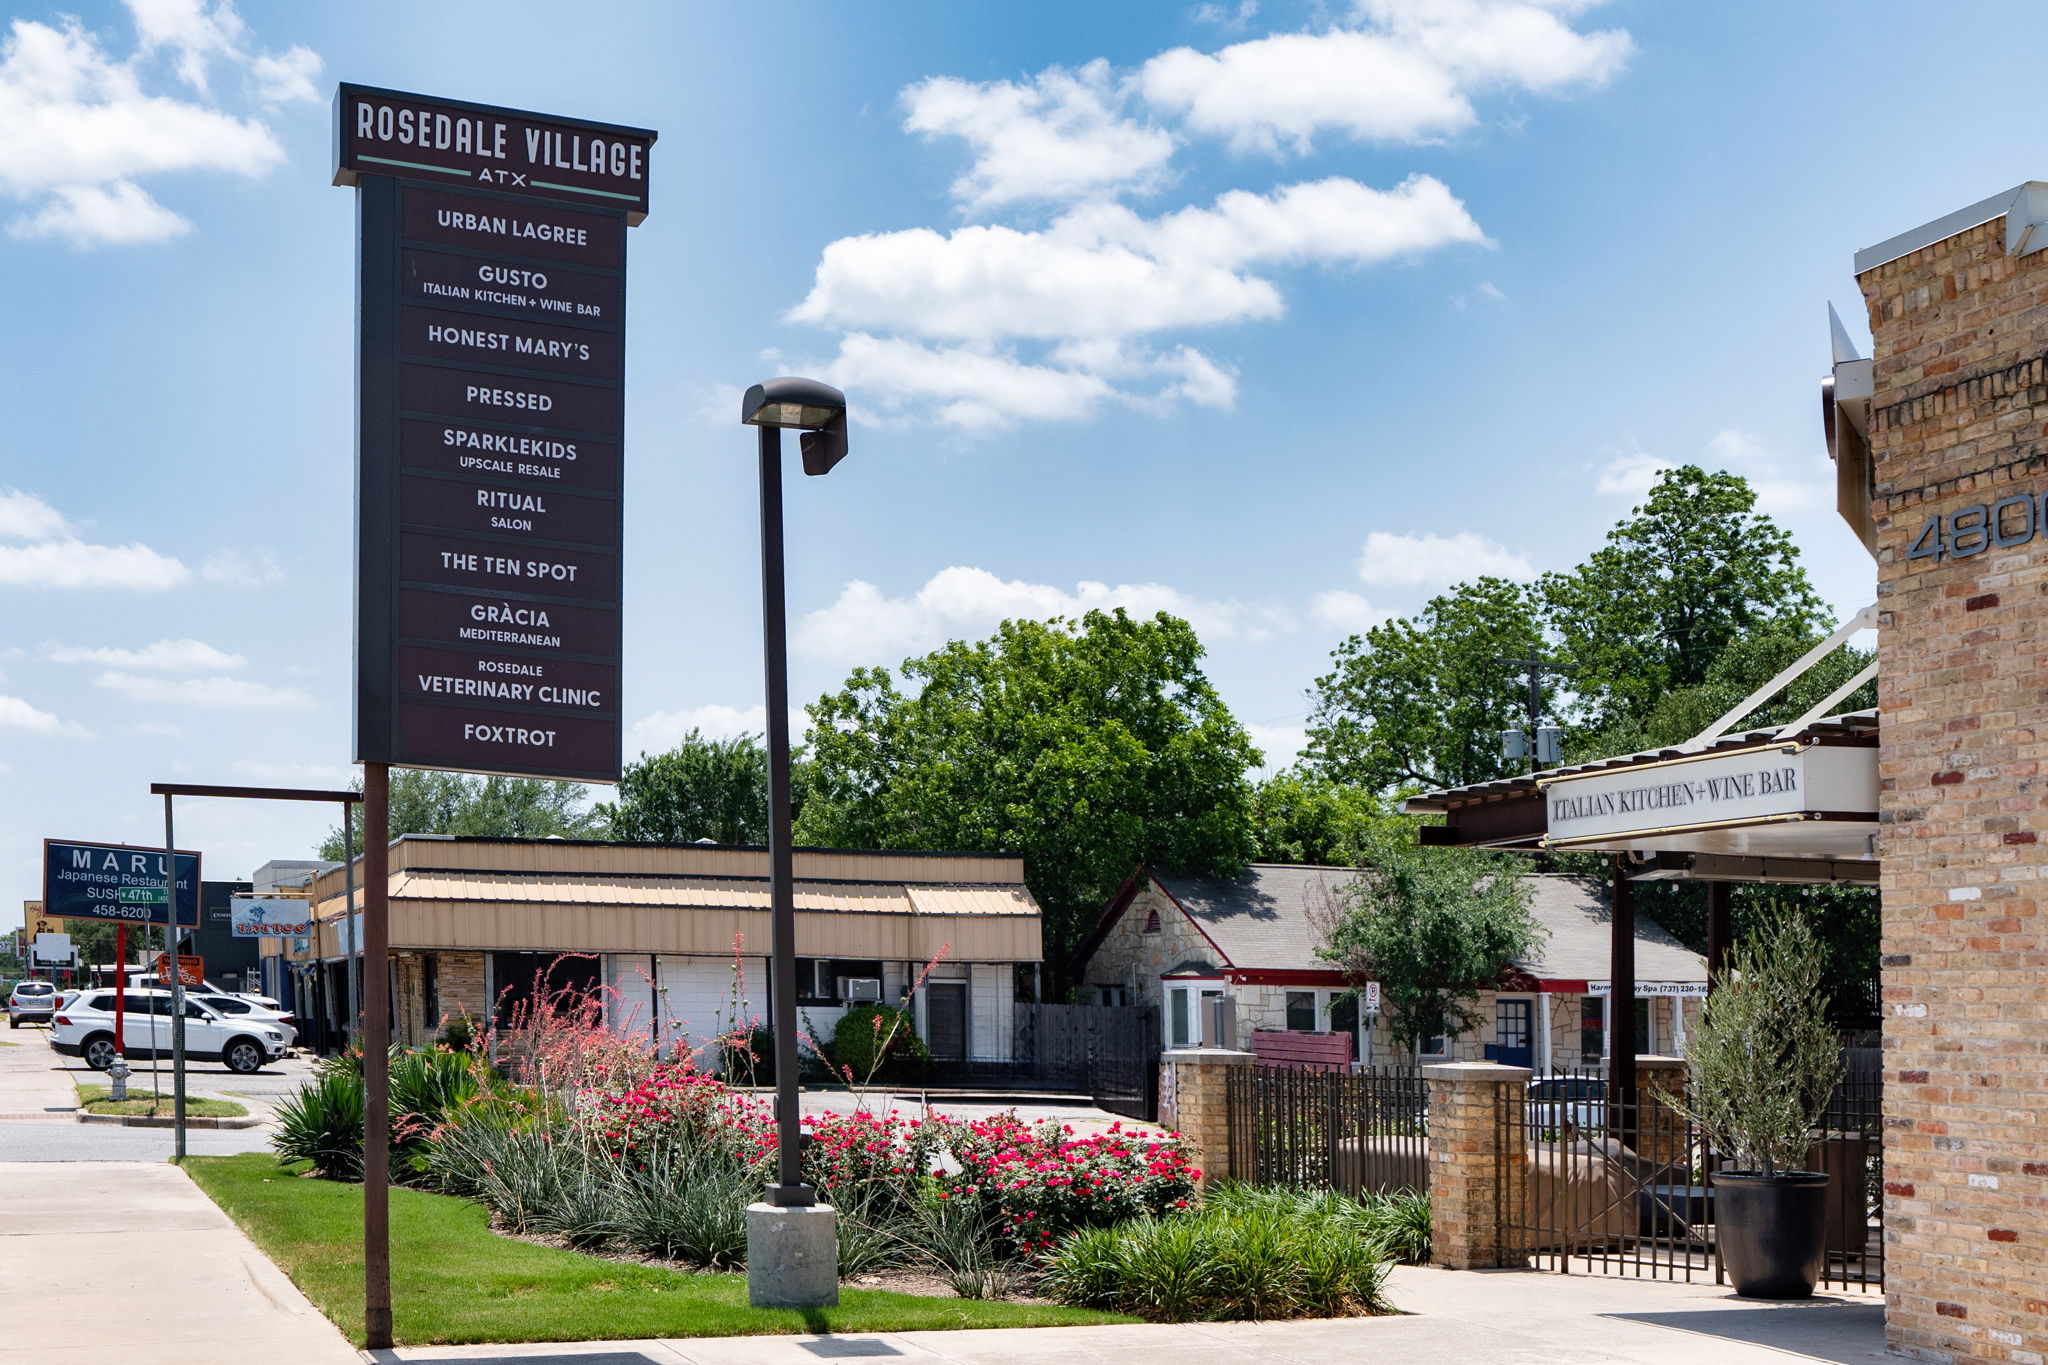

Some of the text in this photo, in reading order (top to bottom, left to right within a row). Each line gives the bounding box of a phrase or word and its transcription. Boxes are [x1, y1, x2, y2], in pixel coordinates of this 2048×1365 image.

[357, 102, 642, 180] ROSEDALE VILLAGE
[479, 168, 526, 186] ATX
[439, 210, 586, 245] URBAN LAGREE
[479, 266, 547, 289] GUSTO
[424, 283, 469, 298] ITALIAN
[475, 290, 526, 306] KITCHEN
[540, 299, 571, 312] WINE
[578, 304, 600, 316] BAR
[429, 326, 589, 360] HONEST MARY'S
[468, 386, 551, 410] PRESSED
[444, 429, 577, 460] SPARKLEKIDS
[460, 457, 560, 478] UPSCALE RESALE
[478, 490, 545, 512] RITUAL
[492, 517, 531, 530] SALON
[1907, 490, 2048, 562] 480
[442, 552, 577, 581] THE TEN SPOT
[471, 603, 549, 627] GRÀCIA
[460, 626, 559, 647] MEDITERRANEAN
[479, 661, 542, 676] ROSEDALE
[419, 673, 600, 706] VETERINARY CLINIC
[465, 724, 555, 746] FOXTROT
[1552, 793, 1615, 822] ITALIAN
[1759, 767, 1797, 795] BAR
[58, 869, 188, 890] Japanese Restaurnt
[87, 887, 120, 899] SUSH
[128, 889, 152, 901] 47th
[236, 923, 307, 934] TATTOO
[164, 957, 197, 965] WNING
[1643, 985, 1657, 993] Spa
[1660, 985, 1679, 993] (737)
